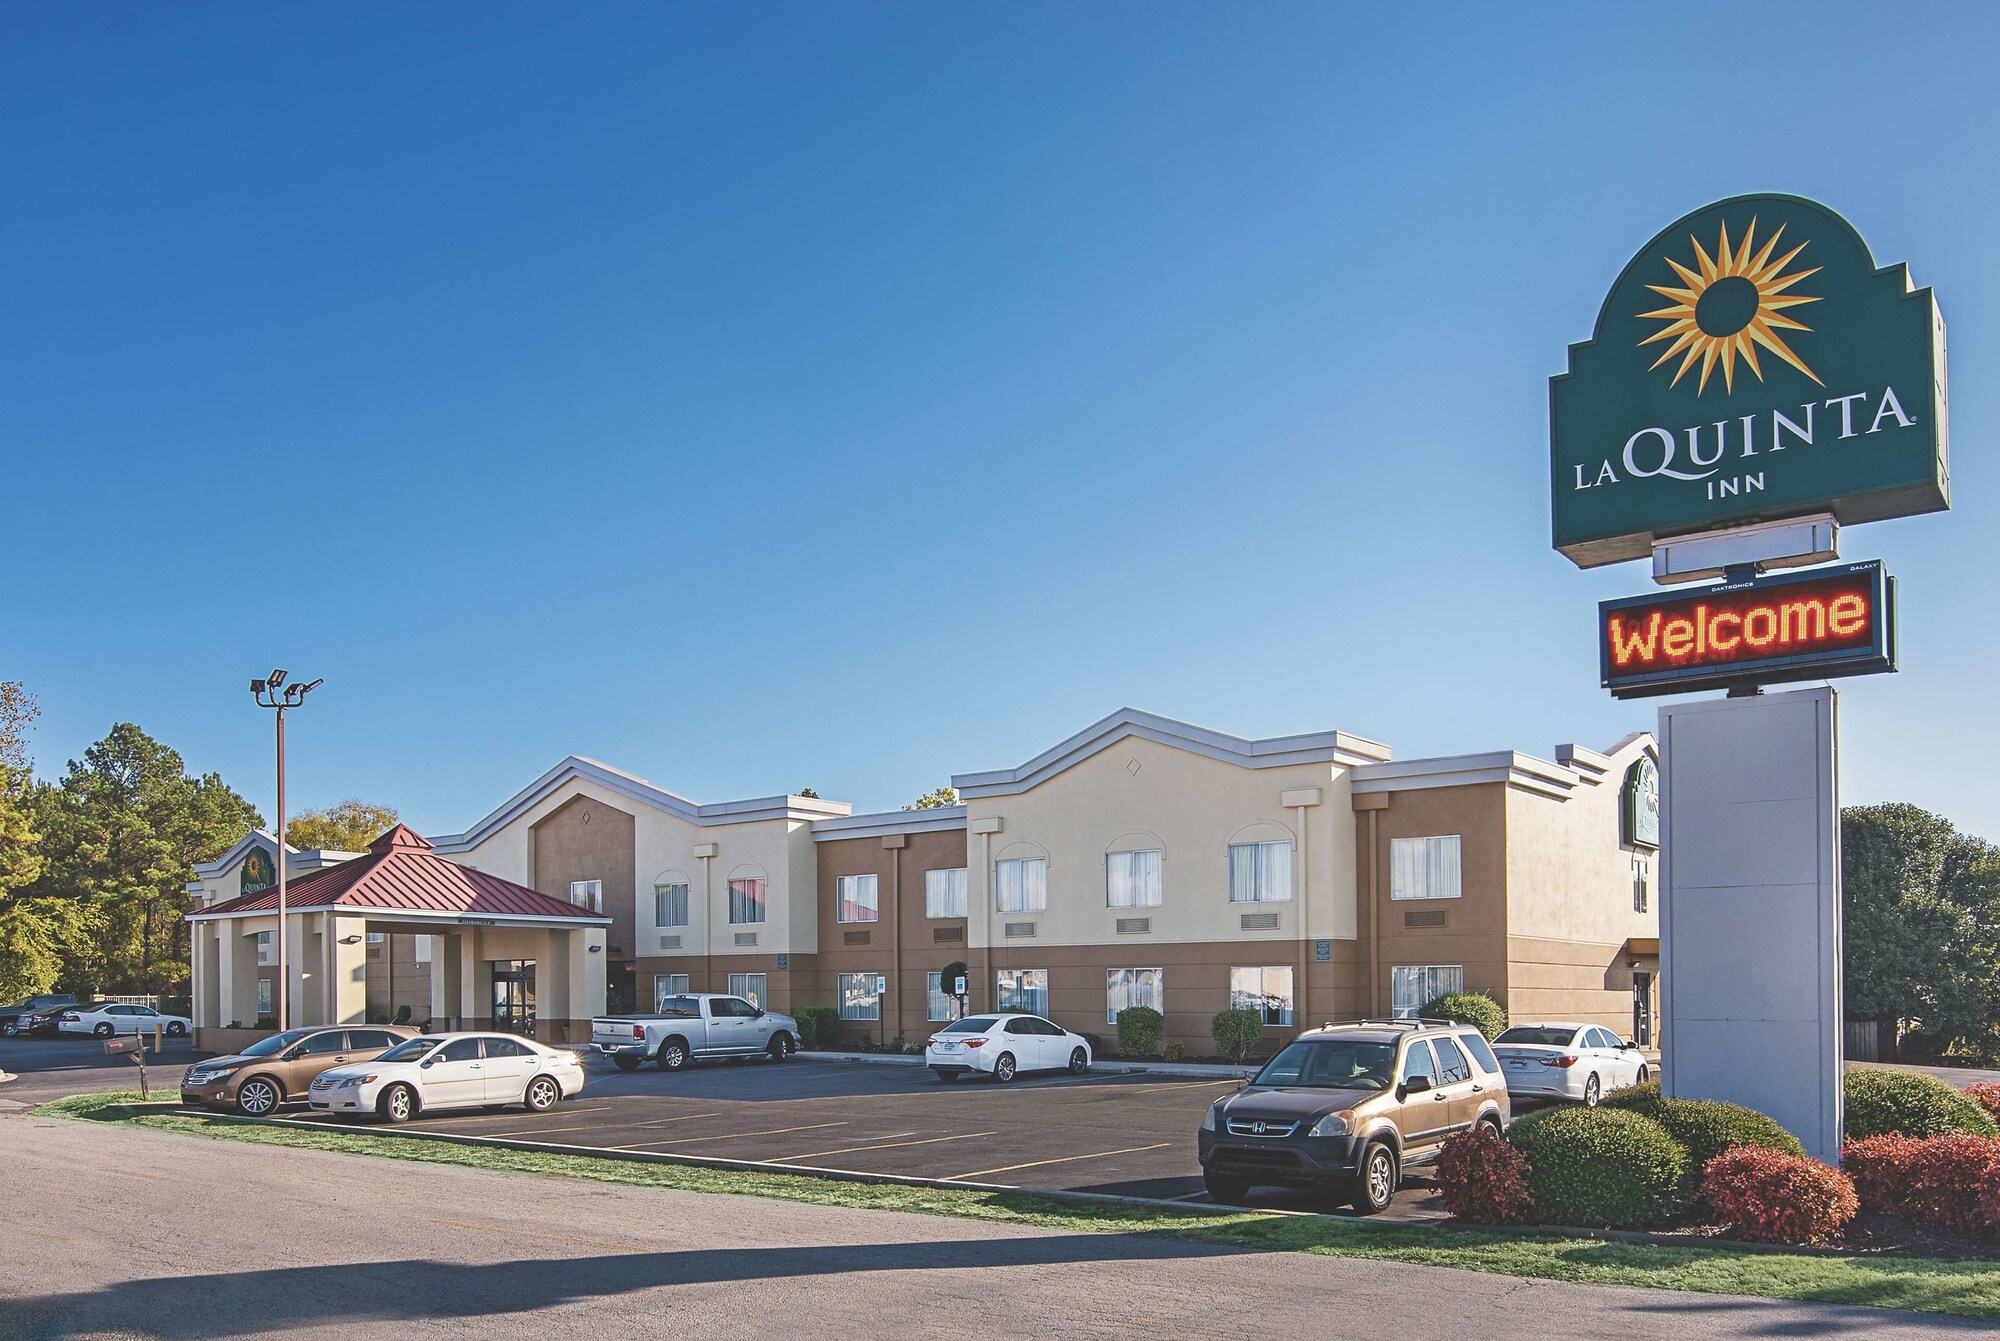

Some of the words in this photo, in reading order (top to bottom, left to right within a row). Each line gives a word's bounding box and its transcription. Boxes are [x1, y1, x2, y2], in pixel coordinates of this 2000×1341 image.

[1574, 459, 1621, 490] LA
[1622, 386, 1917, 481] QUINTA
[1707, 472, 1765, 500] INN
[1850, 563, 1877, 572] GALAXY
[1711, 581, 1754, 593] DAKTRONICS
[1611, 594, 1865, 664] Welcome
